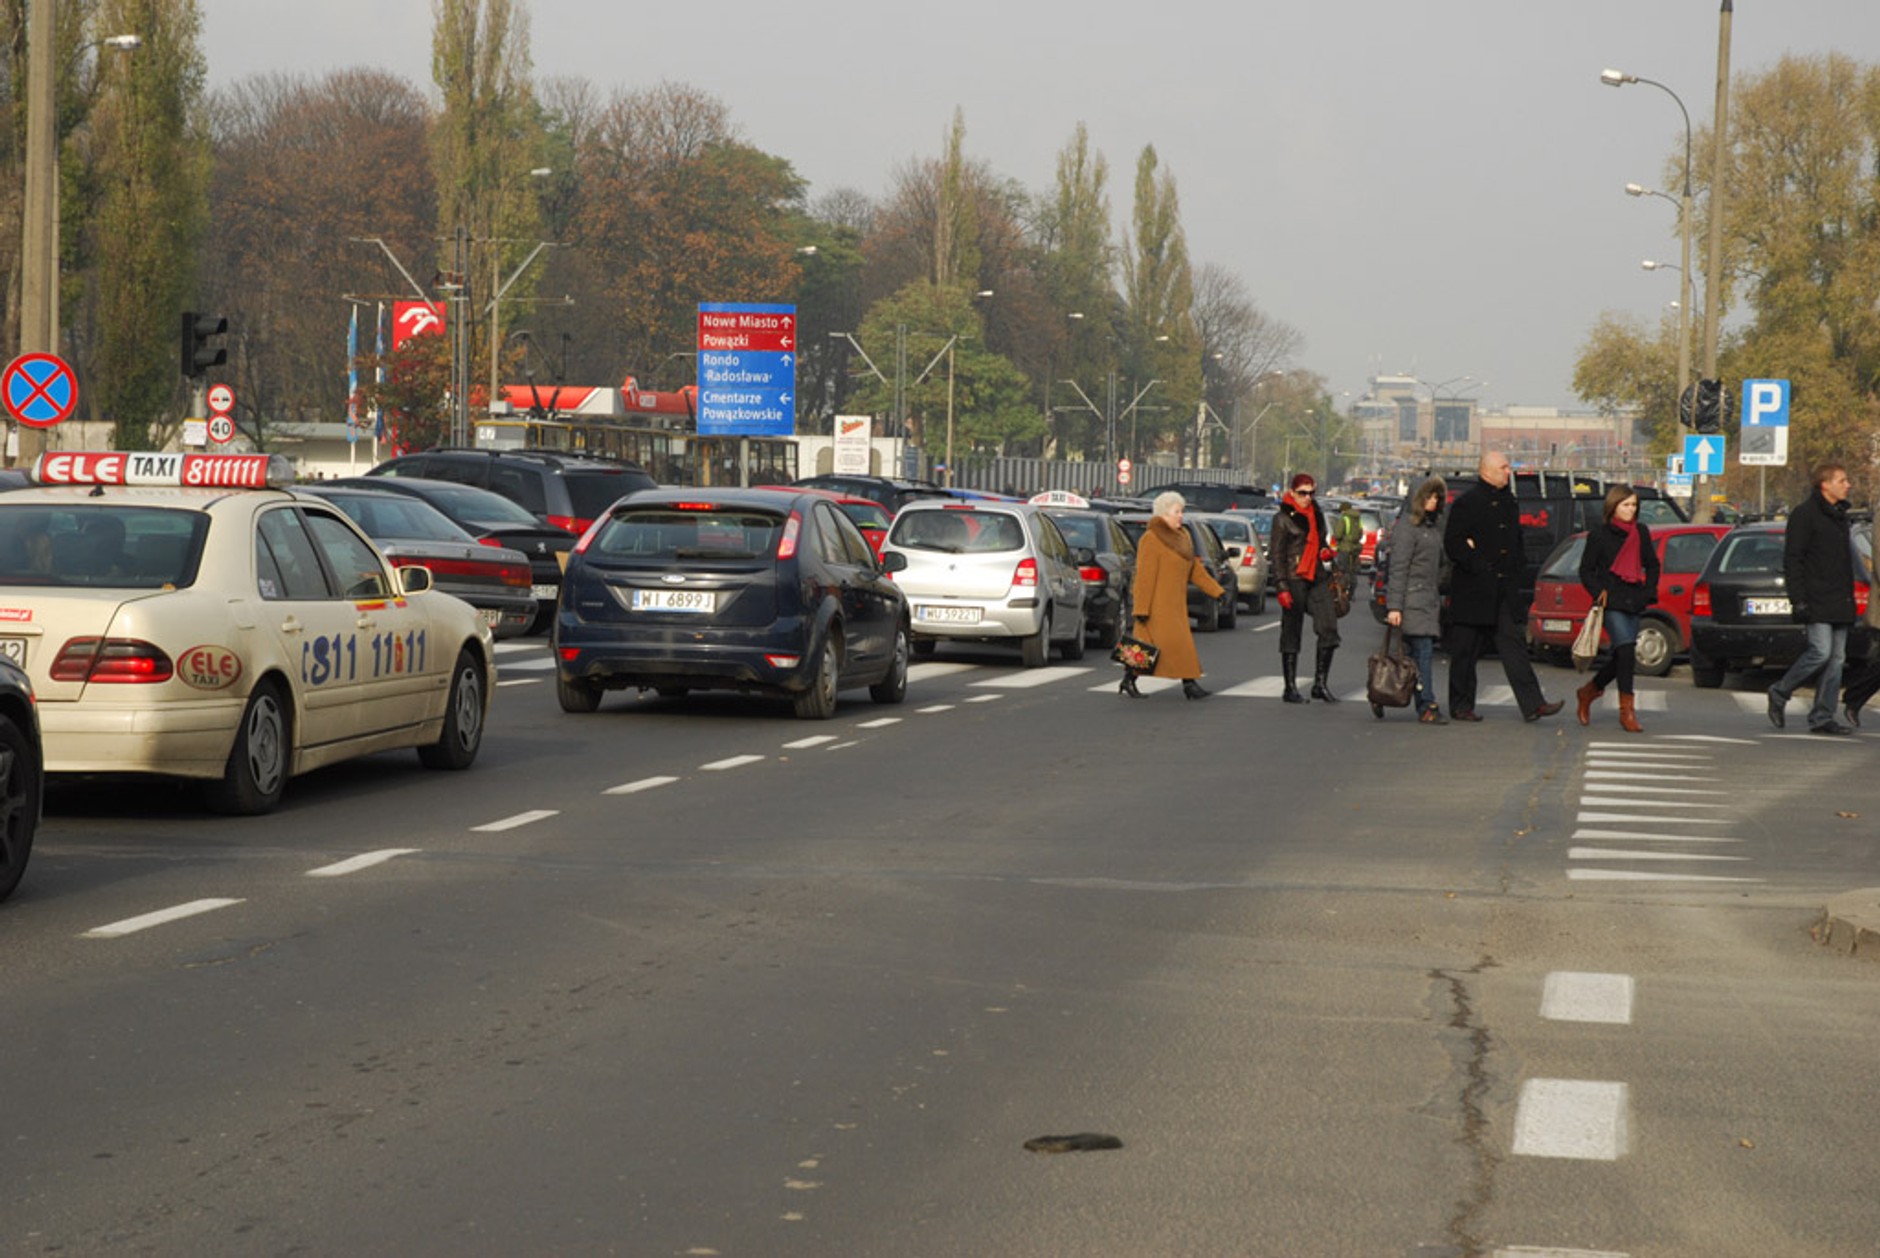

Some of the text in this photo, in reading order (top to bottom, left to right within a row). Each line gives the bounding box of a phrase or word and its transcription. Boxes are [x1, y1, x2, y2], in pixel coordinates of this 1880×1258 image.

[703, 314, 779, 329] Nowe Miasto
[703, 334, 749, 350] Powązki
[703, 354, 740, 367] Rondo
[703, 391, 763, 405] Cmentarze
[1750, 383, 1782, 425] P
[703, 407, 784, 423] Powązkowskie
[211, 421, 231, 435] 40
[46, 455, 261, 484] ELE TAXI 8111111
[641, 592, 661, 606] WI
[191, 652, 233, 677] ELE
[192, 673, 220, 685] TAXI
